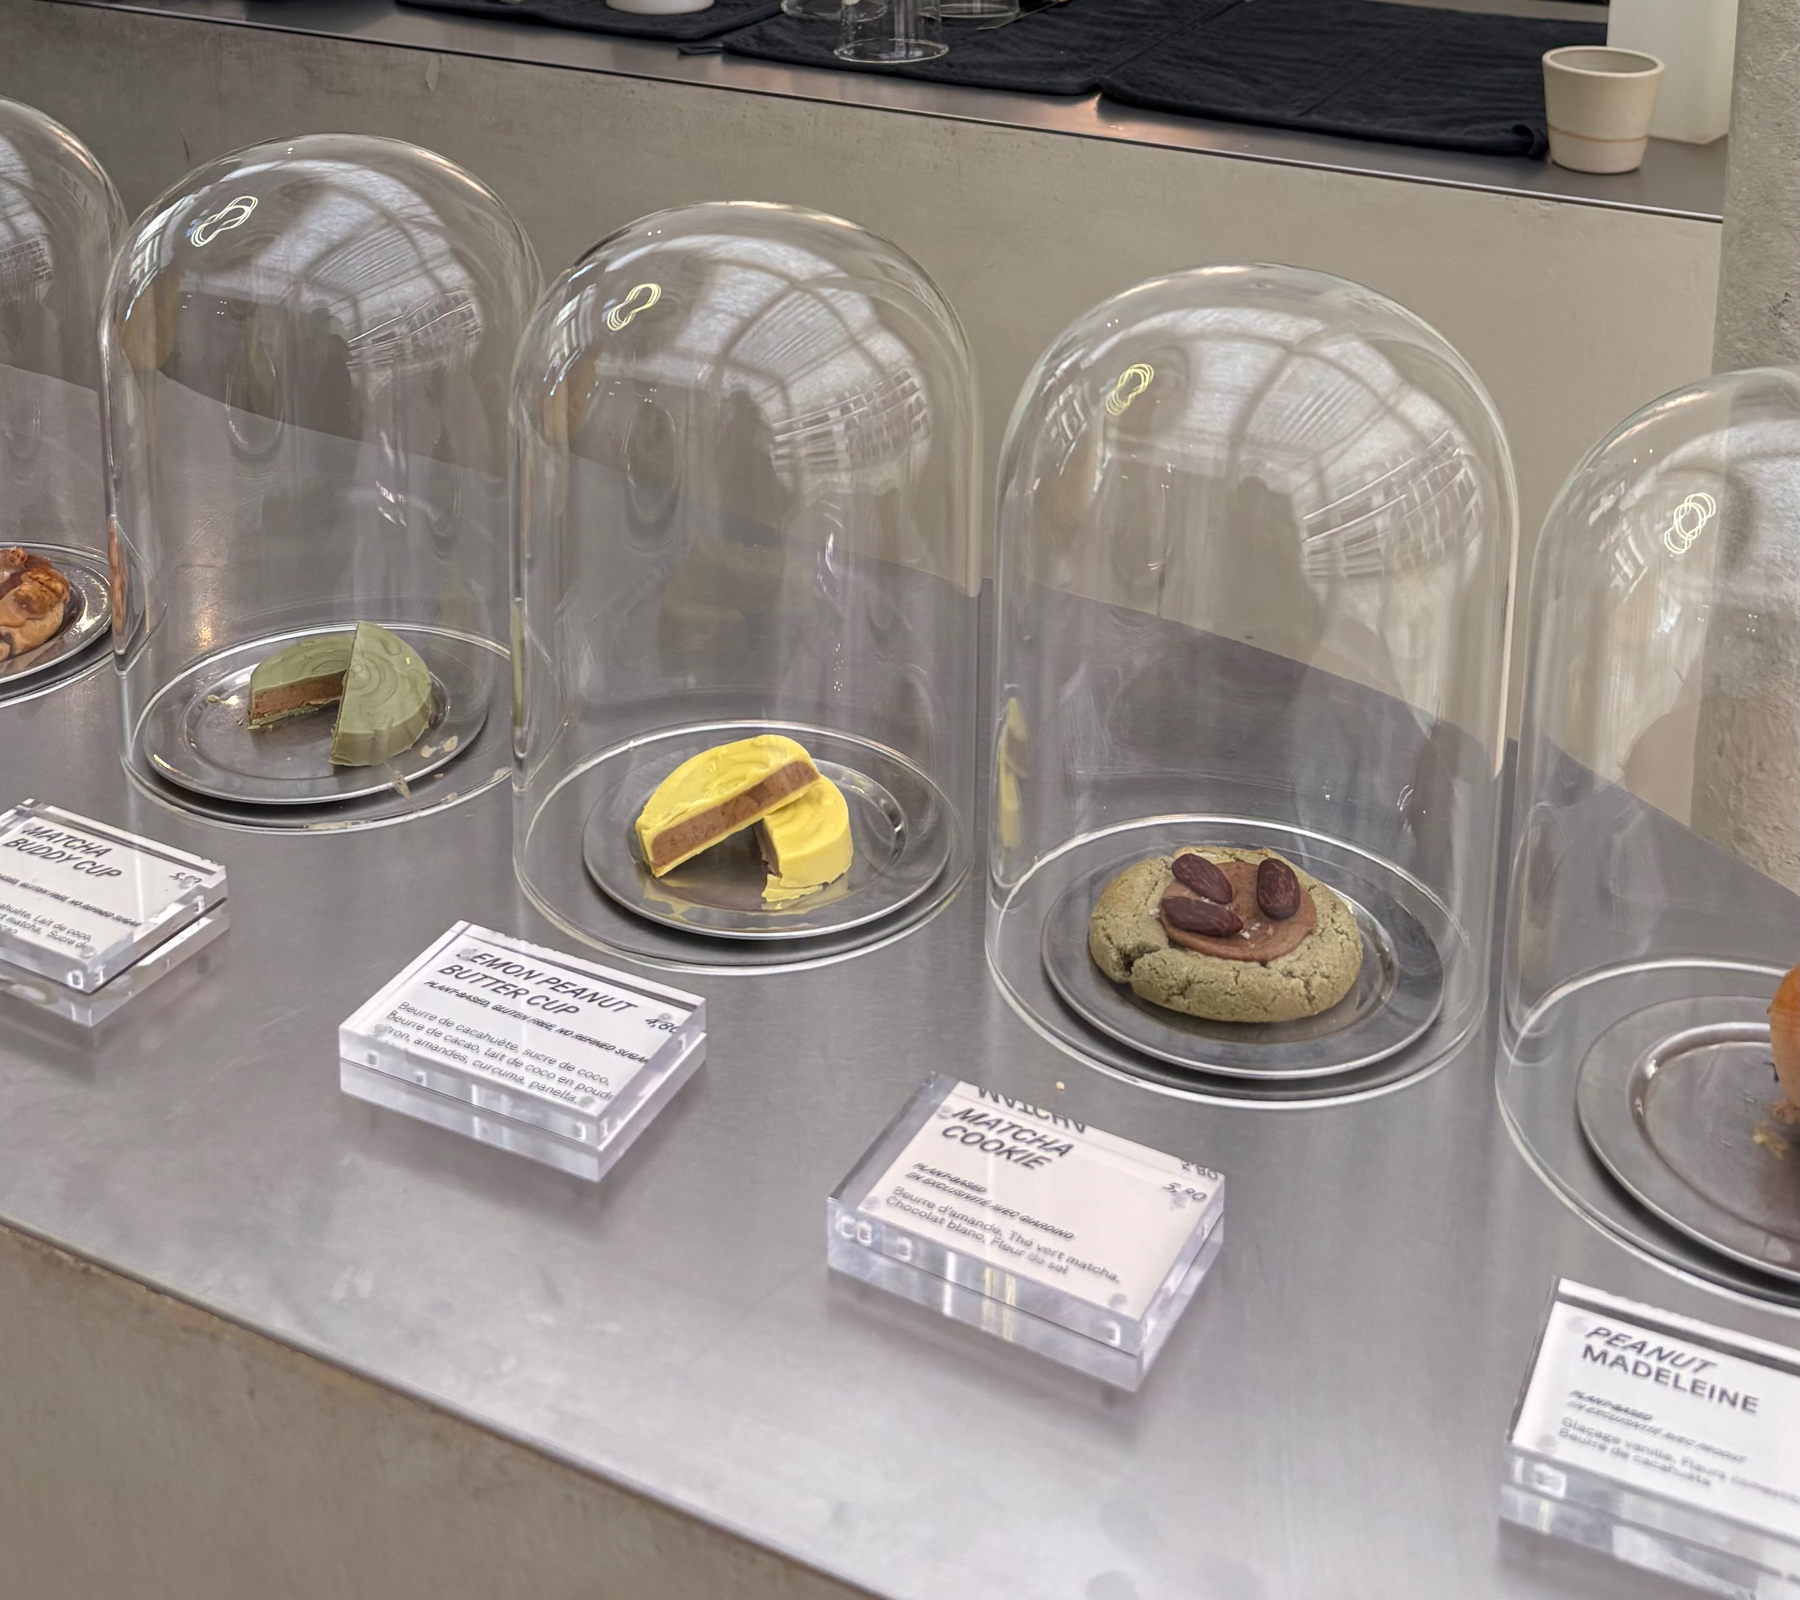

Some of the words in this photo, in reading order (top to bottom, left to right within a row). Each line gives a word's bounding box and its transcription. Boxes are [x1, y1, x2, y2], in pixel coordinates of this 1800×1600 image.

[2, 838, 83, 863] BUDDY
[72, 860, 123, 877] CUP
[21, 825, 113, 858] MATCHA
[33, 915, 55, 927] Lait
[53, 923, 67, 931] de
[47, 930, 75, 945] Sucre
[437, 963, 530, 999] BUTTER
[526, 994, 581, 1016] CUP
[534, 976, 639, 1013] PEANUT
[386, 1009, 425, 1031] Beurre
[425, 1027, 443, 1038] de
[443, 1034, 481, 1053] cacao,
[484, 1047, 507, 1061] lait
[506, 1056, 524, 1068] de
[524, 1063, 557, 1080] coco
[557, 1075, 575, 1087] en
[398, 1000, 438, 1021] Beurre
[438, 1017, 455, 1028] de
[455, 1024, 520, 1053] cacahuète,
[521, 1047, 558, 1065] sucre
[558, 1061, 576, 1072] de
[577, 1068, 610, 1086] coco,
[413, 1037, 470, 1064] amandes,
[491, 1004, 530, 1021] GLUTEN
[555, 1027, 574, 1036] NO
[572, 1033, 617, 1051] REFINED
[942, 1125, 1052, 1170] COOKIE
[951, 1107, 1075, 1157] MATCHA
[912, 1162, 988, 1194] PLANT-BASED
[892, 1185, 937, 1209] Beurre
[1009, 1230, 1033, 1247] Thé
[1036, 1243, 1065, 1260] vert
[904, 1171, 924, 1181] EN
[987, 1203, 1020, 1219] AVEC
[1019, 1214, 1075, 1240] GIARDINO
[886, 1195, 947, 1224] Chocolat
[990, 1235, 1026, 1256] Fleur
[1027, 1252, 1046, 1264] de
[1046, 1260, 1070, 1275] sel
[1584, 1326, 1718, 1374] PEANUT
[1581, 1343, 1761, 1414] MADELEINE
[1558, 1427, 1608, 1451] Beurre
[1610, 1446, 1629, 1459] de
